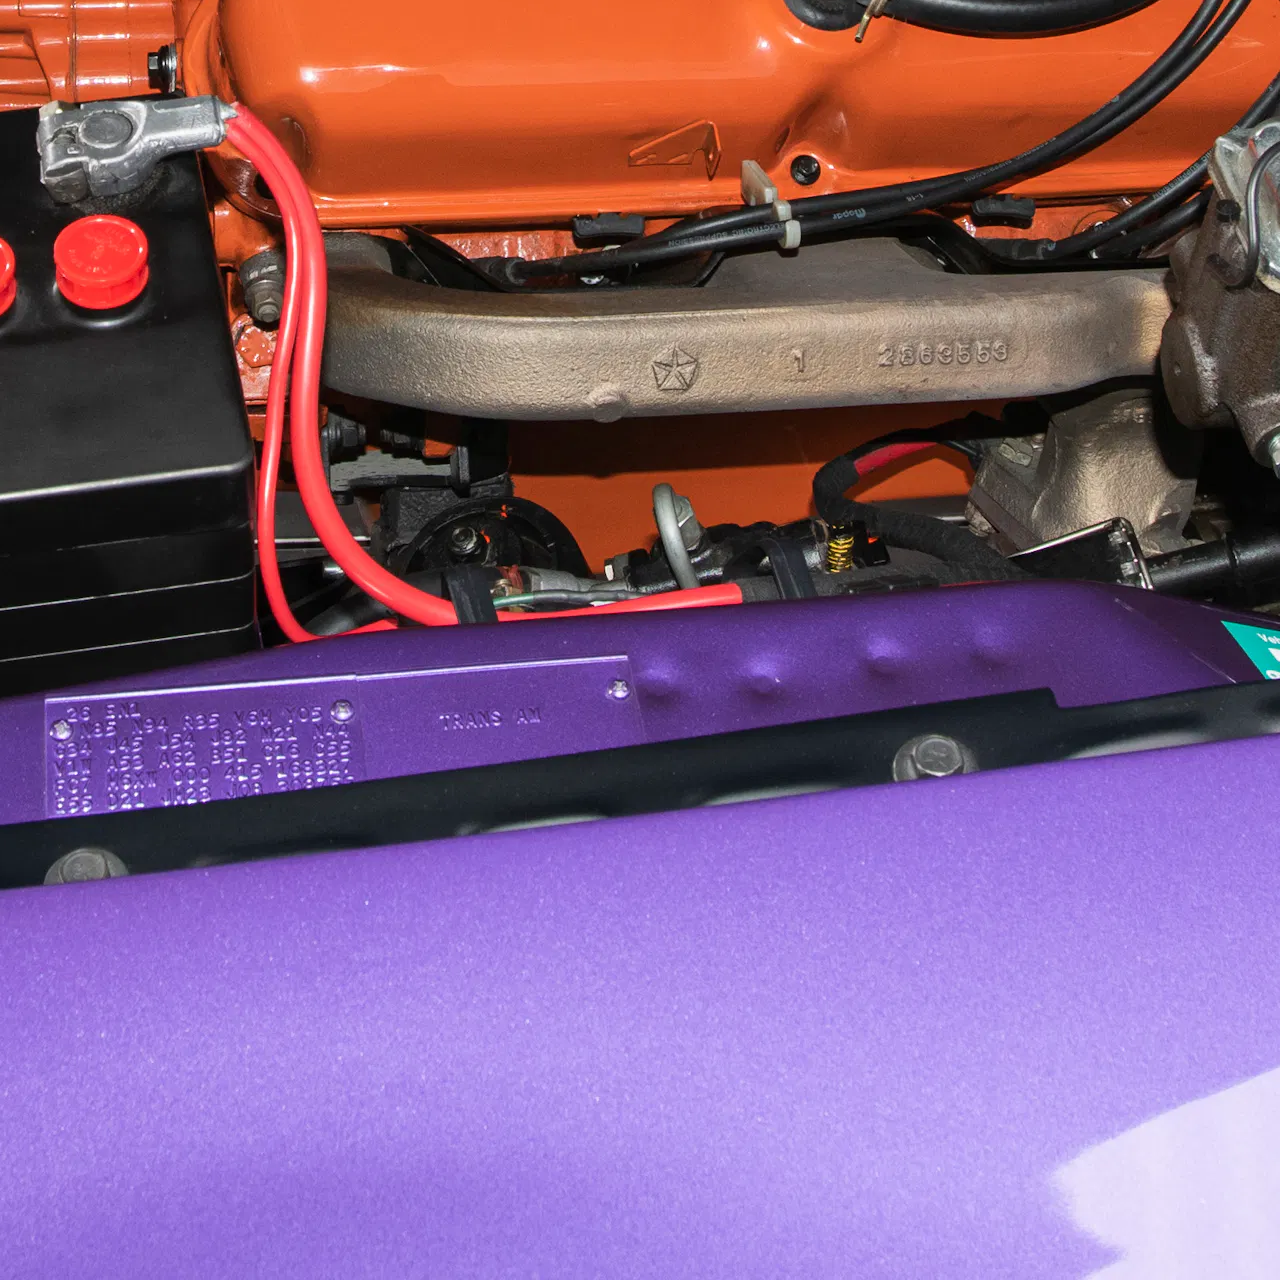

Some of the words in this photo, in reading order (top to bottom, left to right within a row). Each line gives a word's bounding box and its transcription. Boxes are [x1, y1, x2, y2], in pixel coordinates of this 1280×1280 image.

[832, 207, 866, 220] Mopar
[439, 710, 503, 731] TRANS
[517, 707, 542, 725] AM
